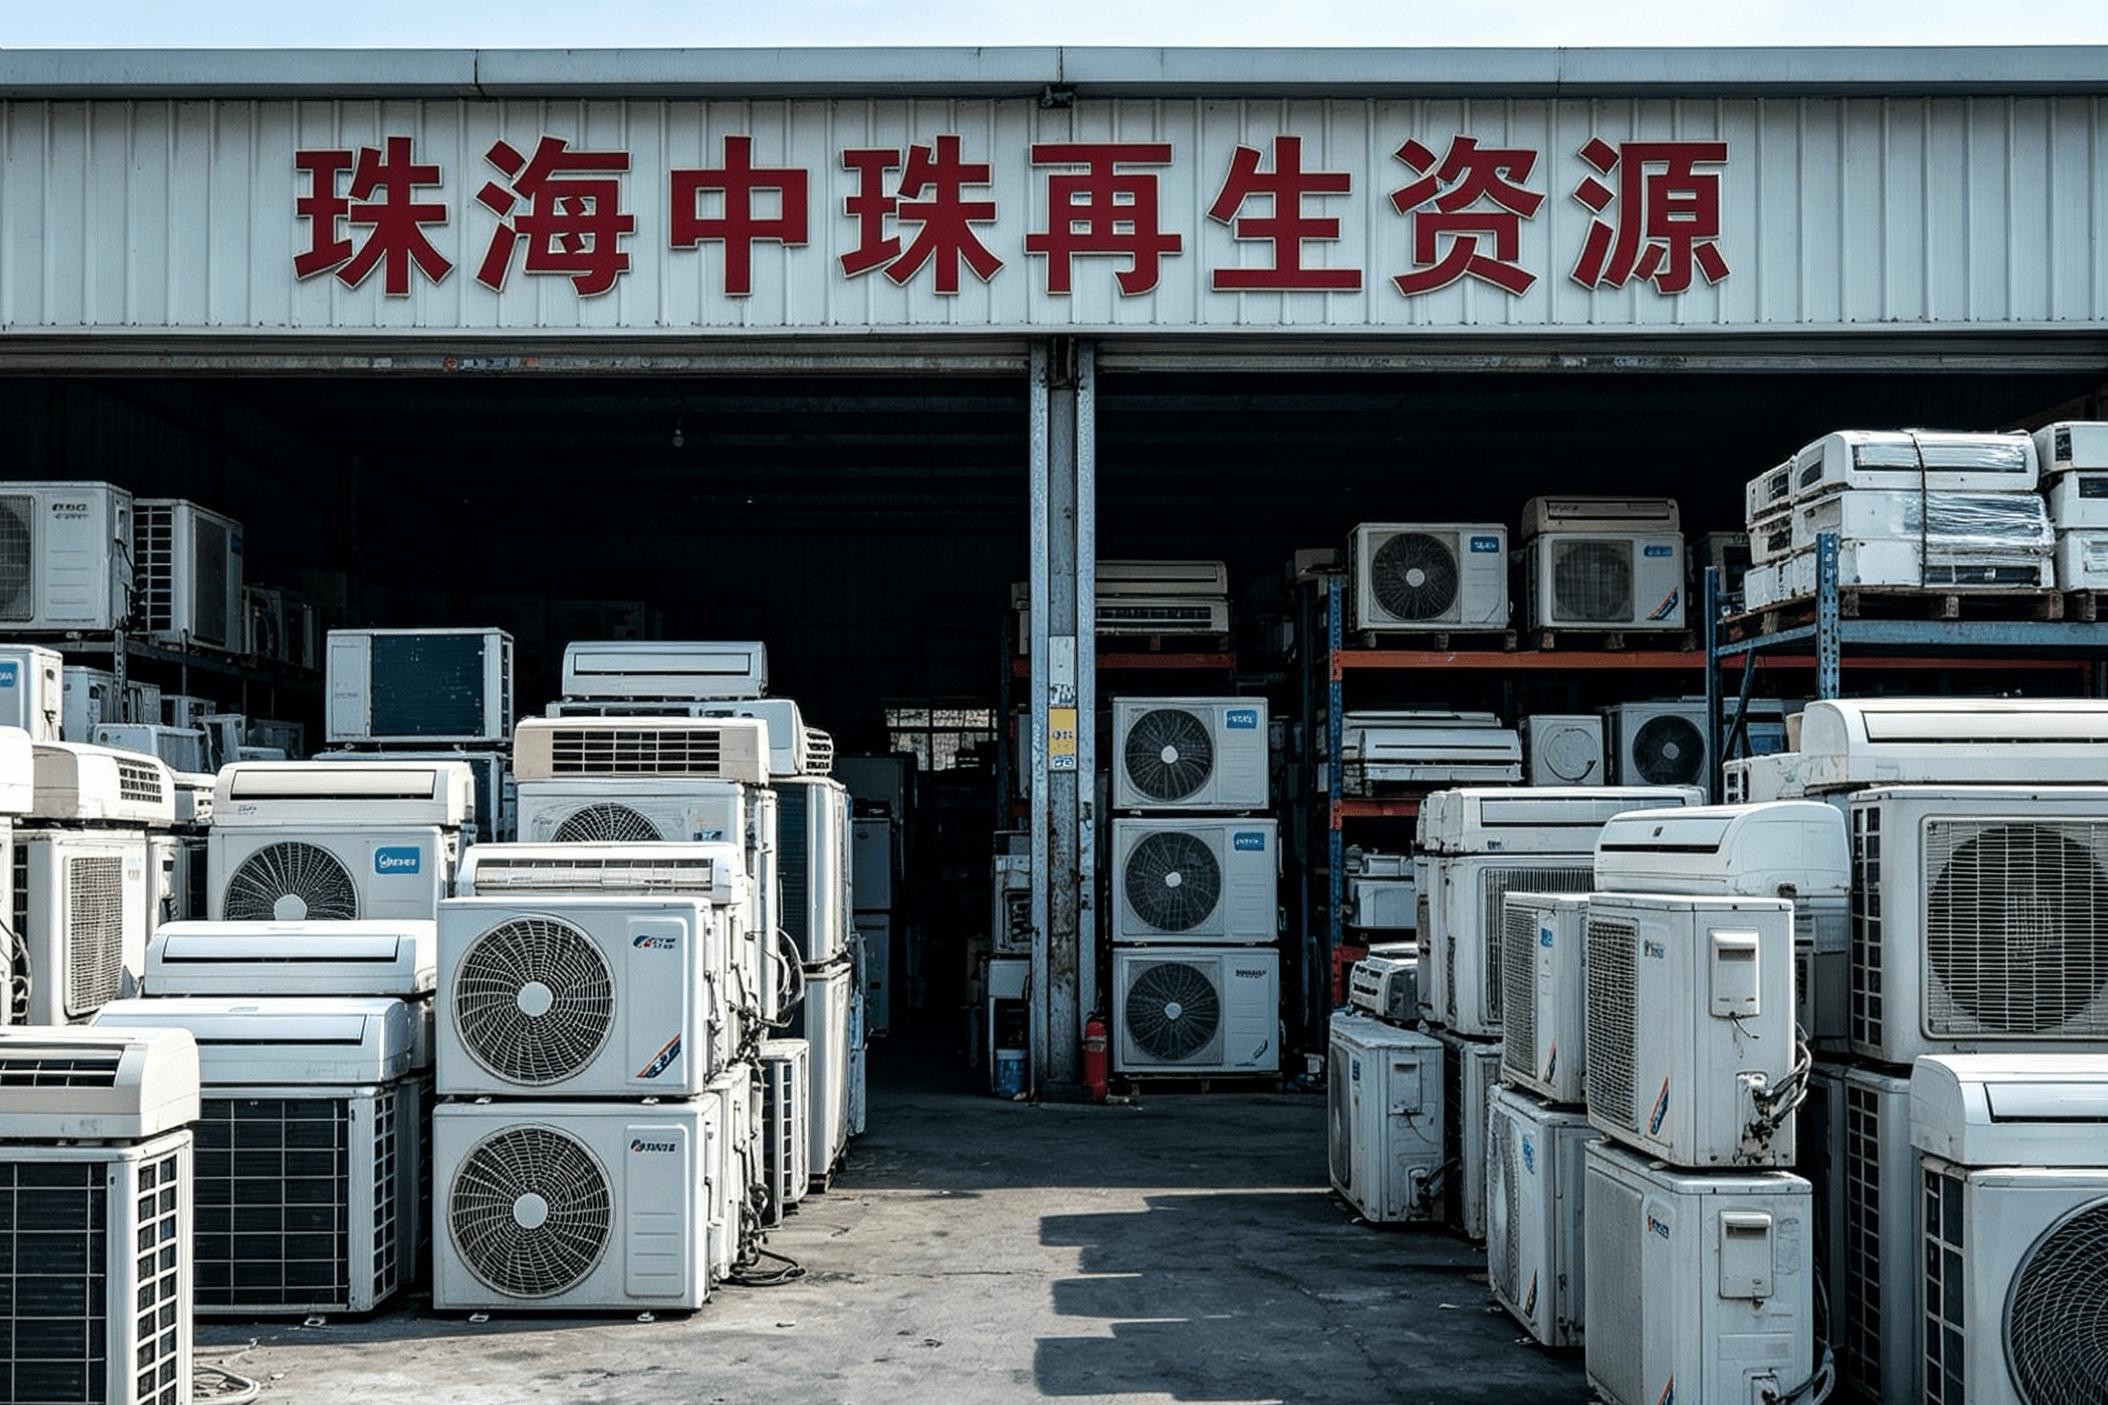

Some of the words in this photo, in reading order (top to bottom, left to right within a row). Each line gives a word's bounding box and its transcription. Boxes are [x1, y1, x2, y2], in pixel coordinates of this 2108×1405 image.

[295, 136, 1728, 297] 珠海中珠再生资源
